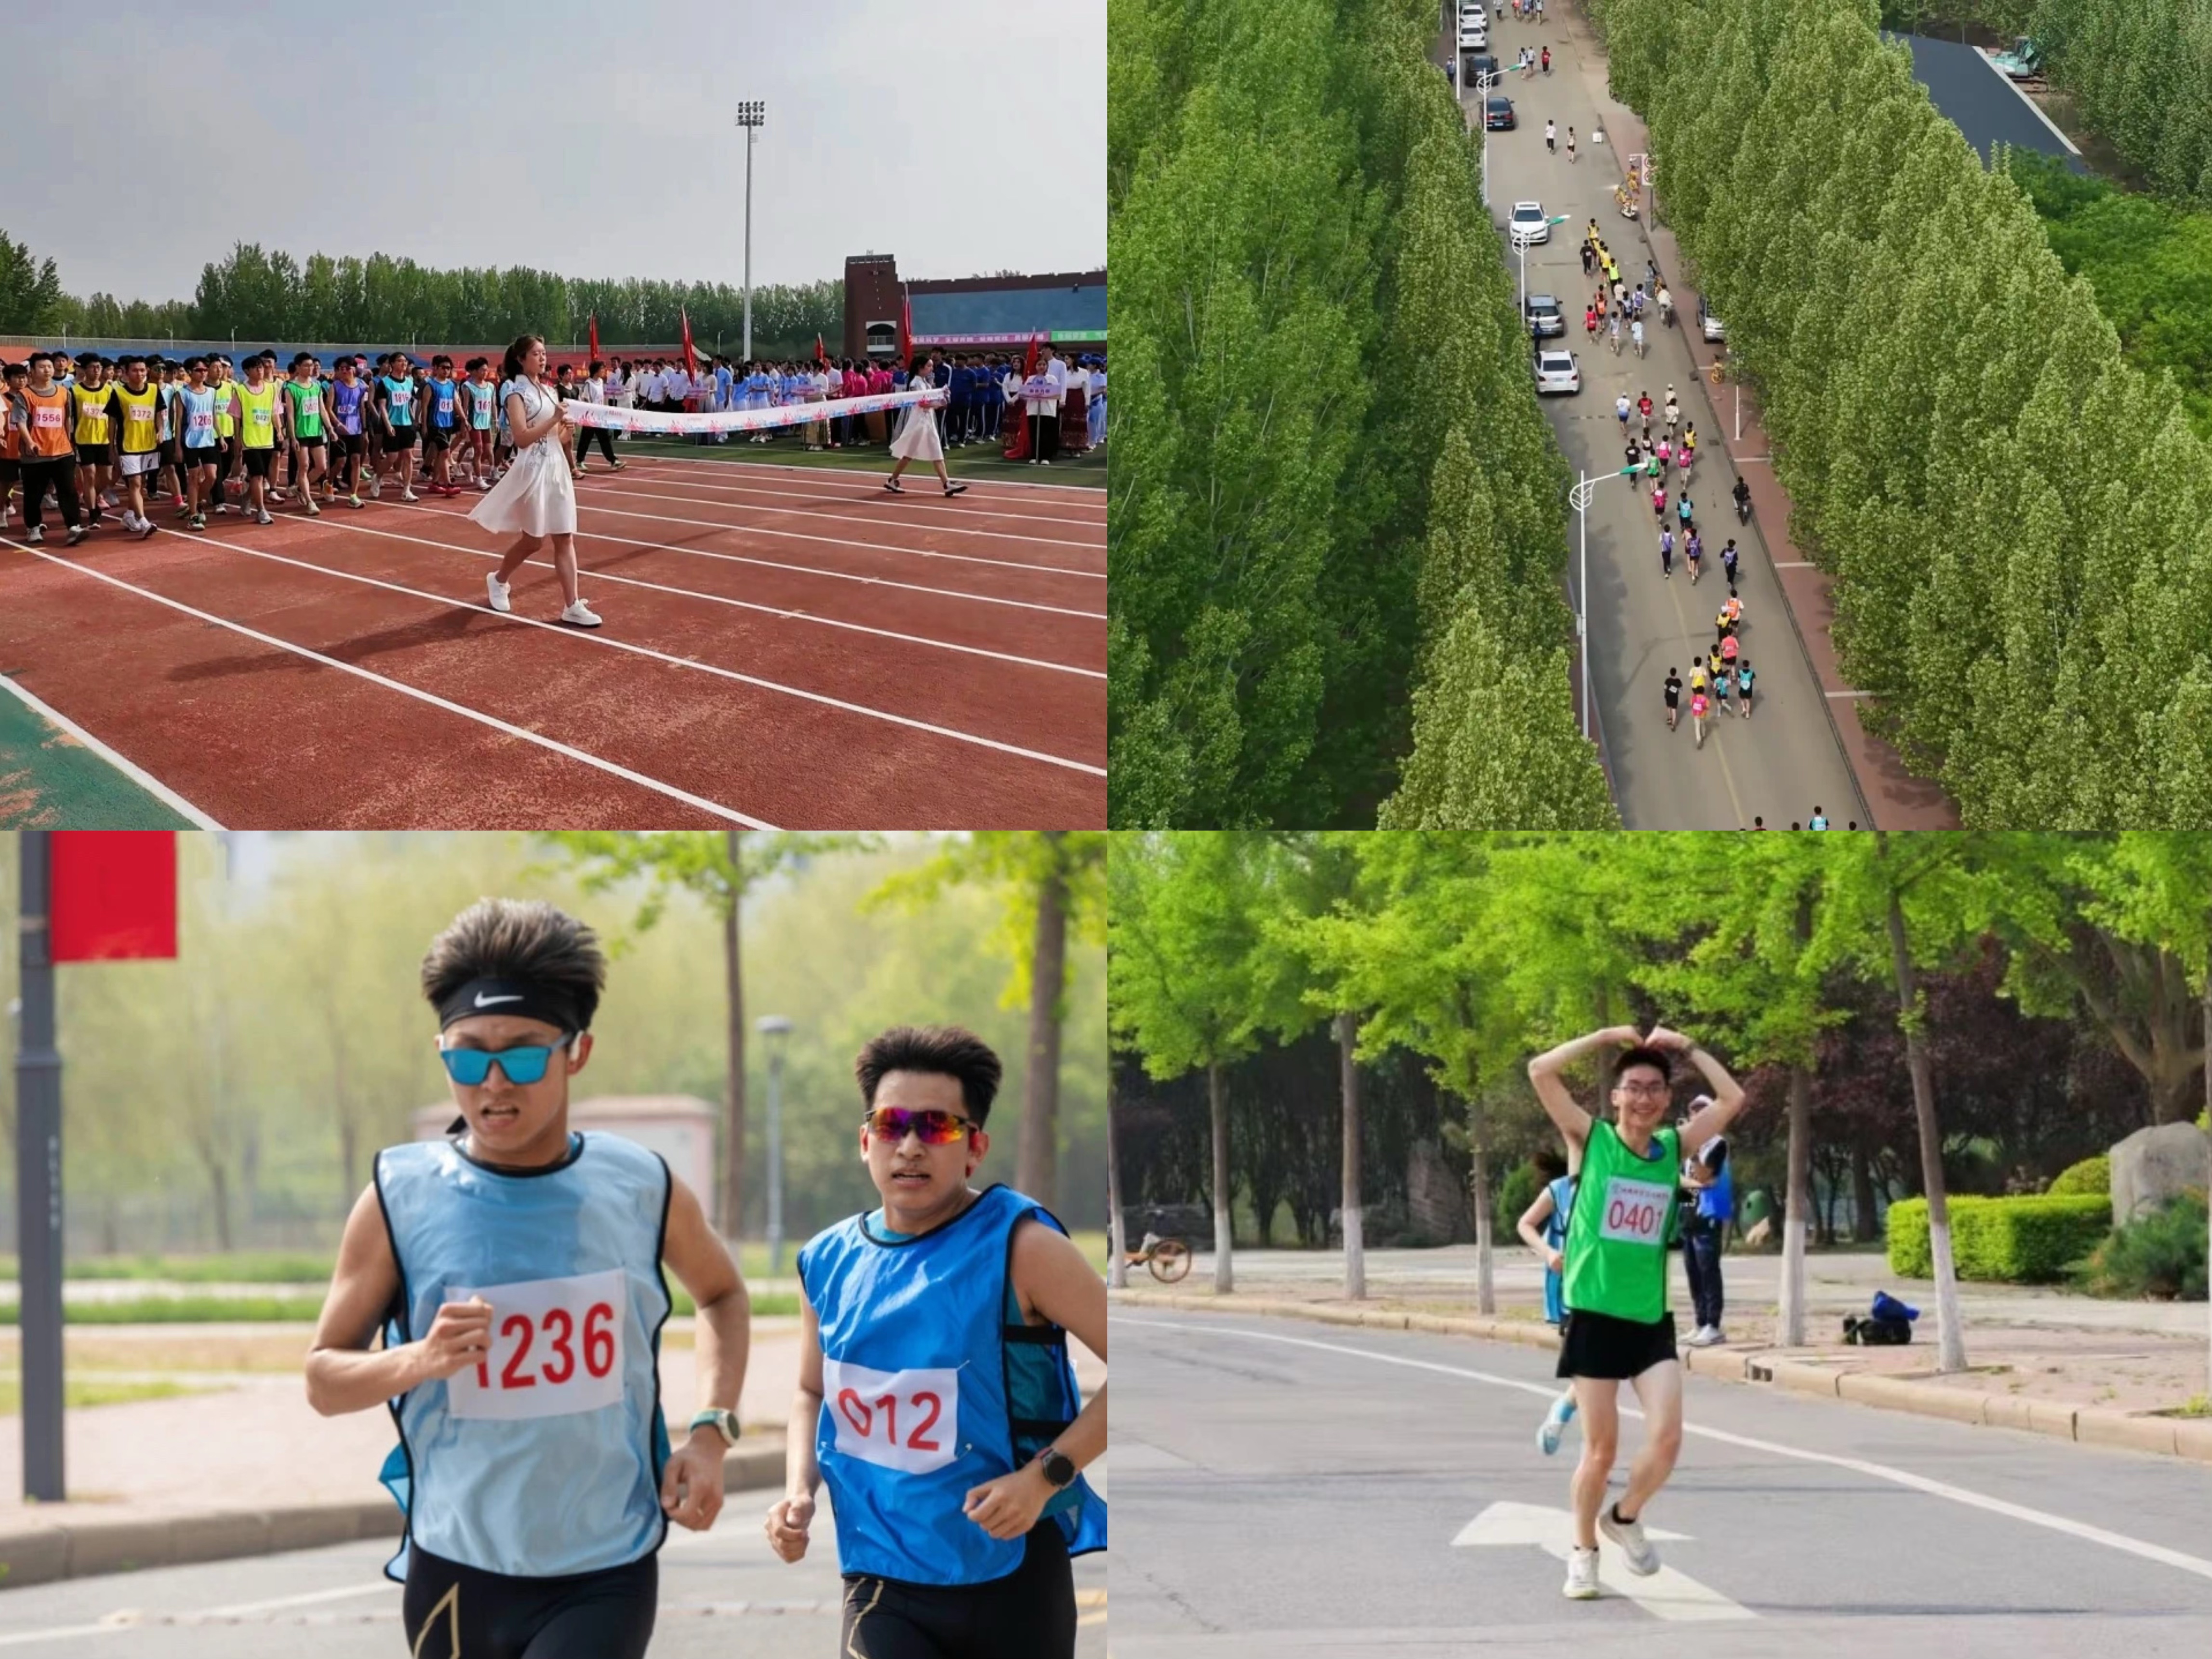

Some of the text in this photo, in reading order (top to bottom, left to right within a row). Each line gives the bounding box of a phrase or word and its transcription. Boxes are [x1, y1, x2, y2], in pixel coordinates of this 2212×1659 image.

[37, 414, 61, 422] 1556
[132, 410, 152, 418] 1372
[1609, 1200, 1663, 1235] 0401
[838, 1388, 942, 1452] 012
